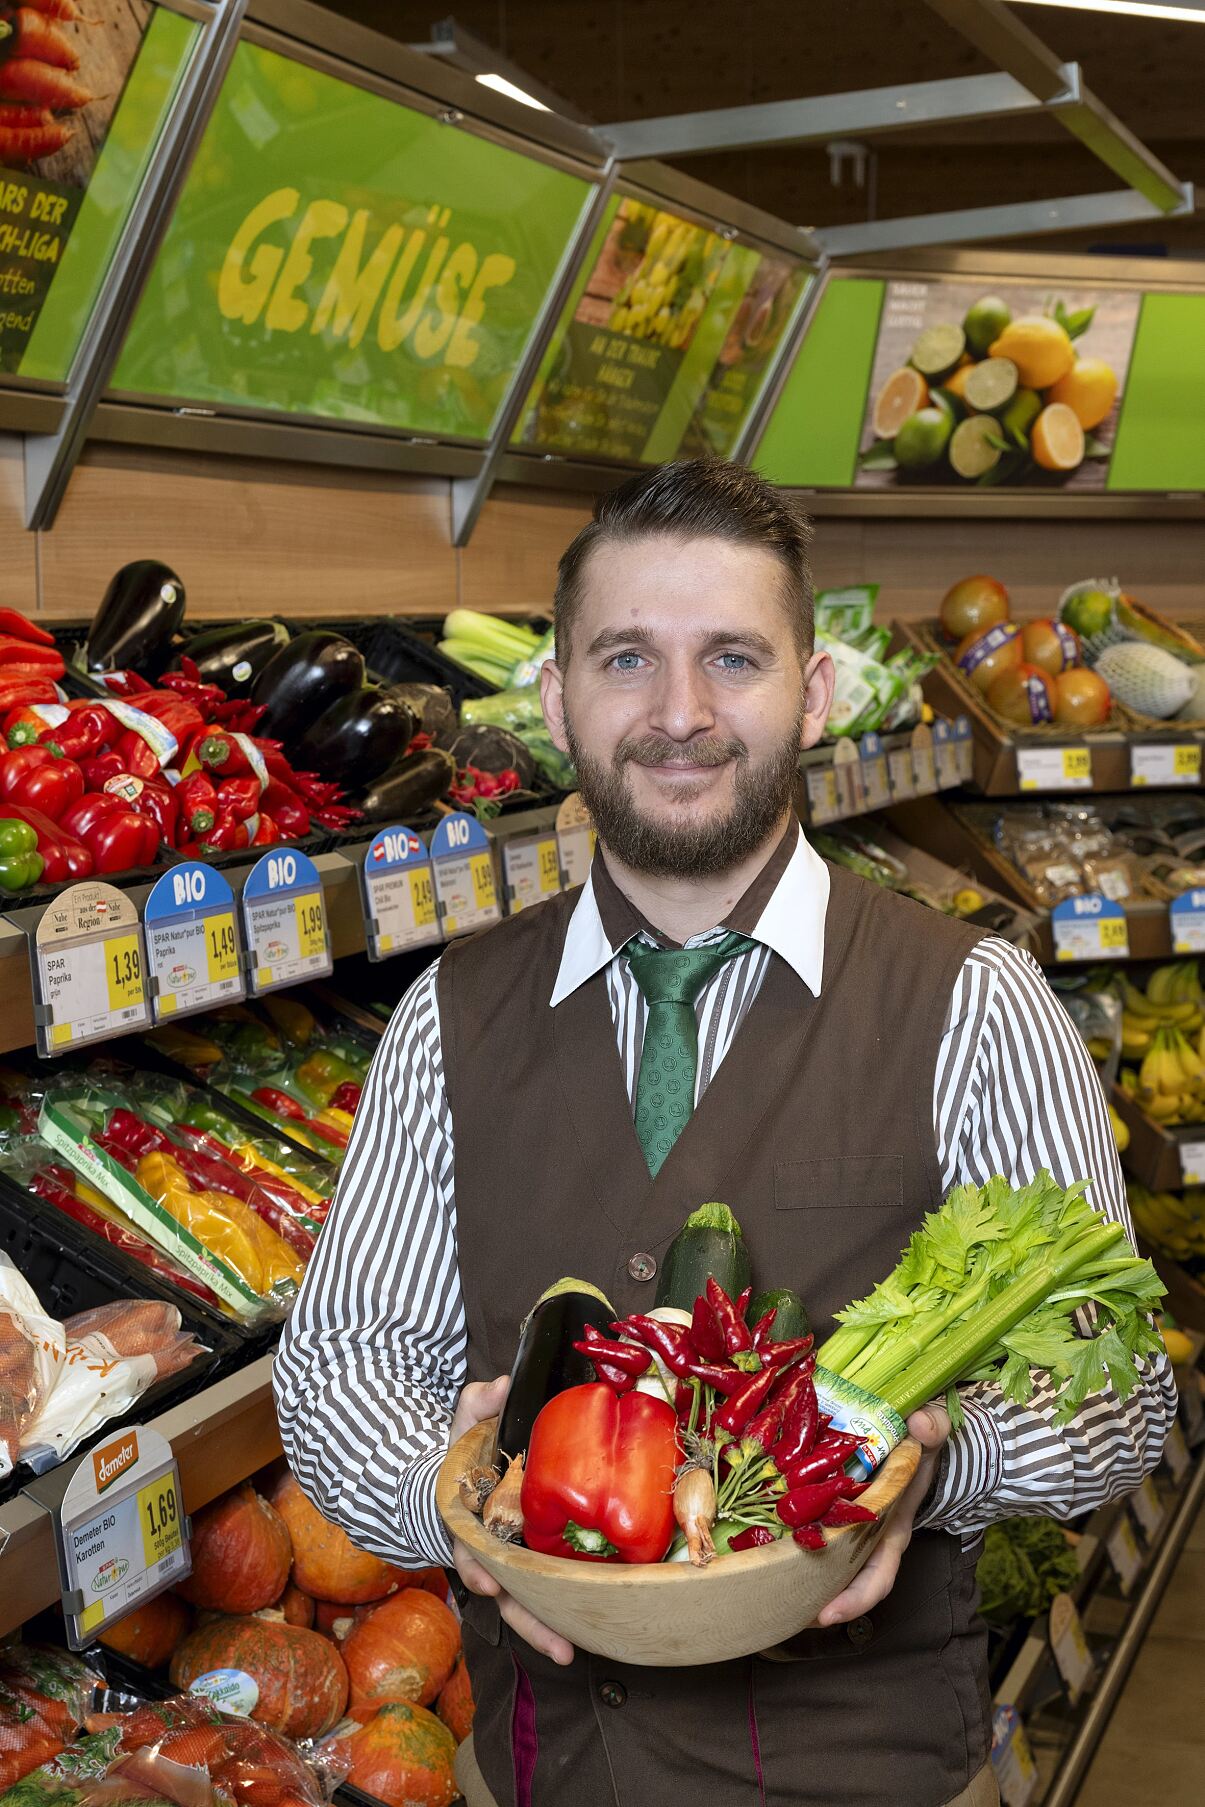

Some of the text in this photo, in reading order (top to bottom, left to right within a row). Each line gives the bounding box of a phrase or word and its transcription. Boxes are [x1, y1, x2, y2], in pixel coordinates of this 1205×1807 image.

[30, 191, 68, 225] DER
[217, 186, 517, 369] GEMÜSE
[383, 832, 409, 863] BIO
[446, 818, 470, 848] BIO
[173, 869, 206, 906] BIO
[267, 855, 297, 889] BIO
[78, 916, 101, 931] Region
[88, 903, 97, 912] der
[302, 905, 322, 938] 1,99
[154, 932, 170, 945] SPAR
[195, 924, 205, 935] BIO
[211, 926, 235, 962] 1,49
[47, 958, 66, 972] SPAR
[156, 946, 176, 958] Paprika
[49, 972, 72, 986] Paprika
[113, 949, 140, 989] 1,39
[127, 990, 135, 998] per
[54, 1134, 97, 1176] Spitzpaprika
[96, 1171, 109, 1188] Mix
[175, 1245, 219, 1287] Spitzpaprika
[219, 1283, 233, 1299] Mix
[98, 1444, 133, 1482] demeter
[861, 1445, 877, 1467] SPAR
[147, 1488, 176, 1537] 1,69
[73, 1514, 116, 1548] Demeter BIO
[76, 1540, 105, 1564] Karotten
